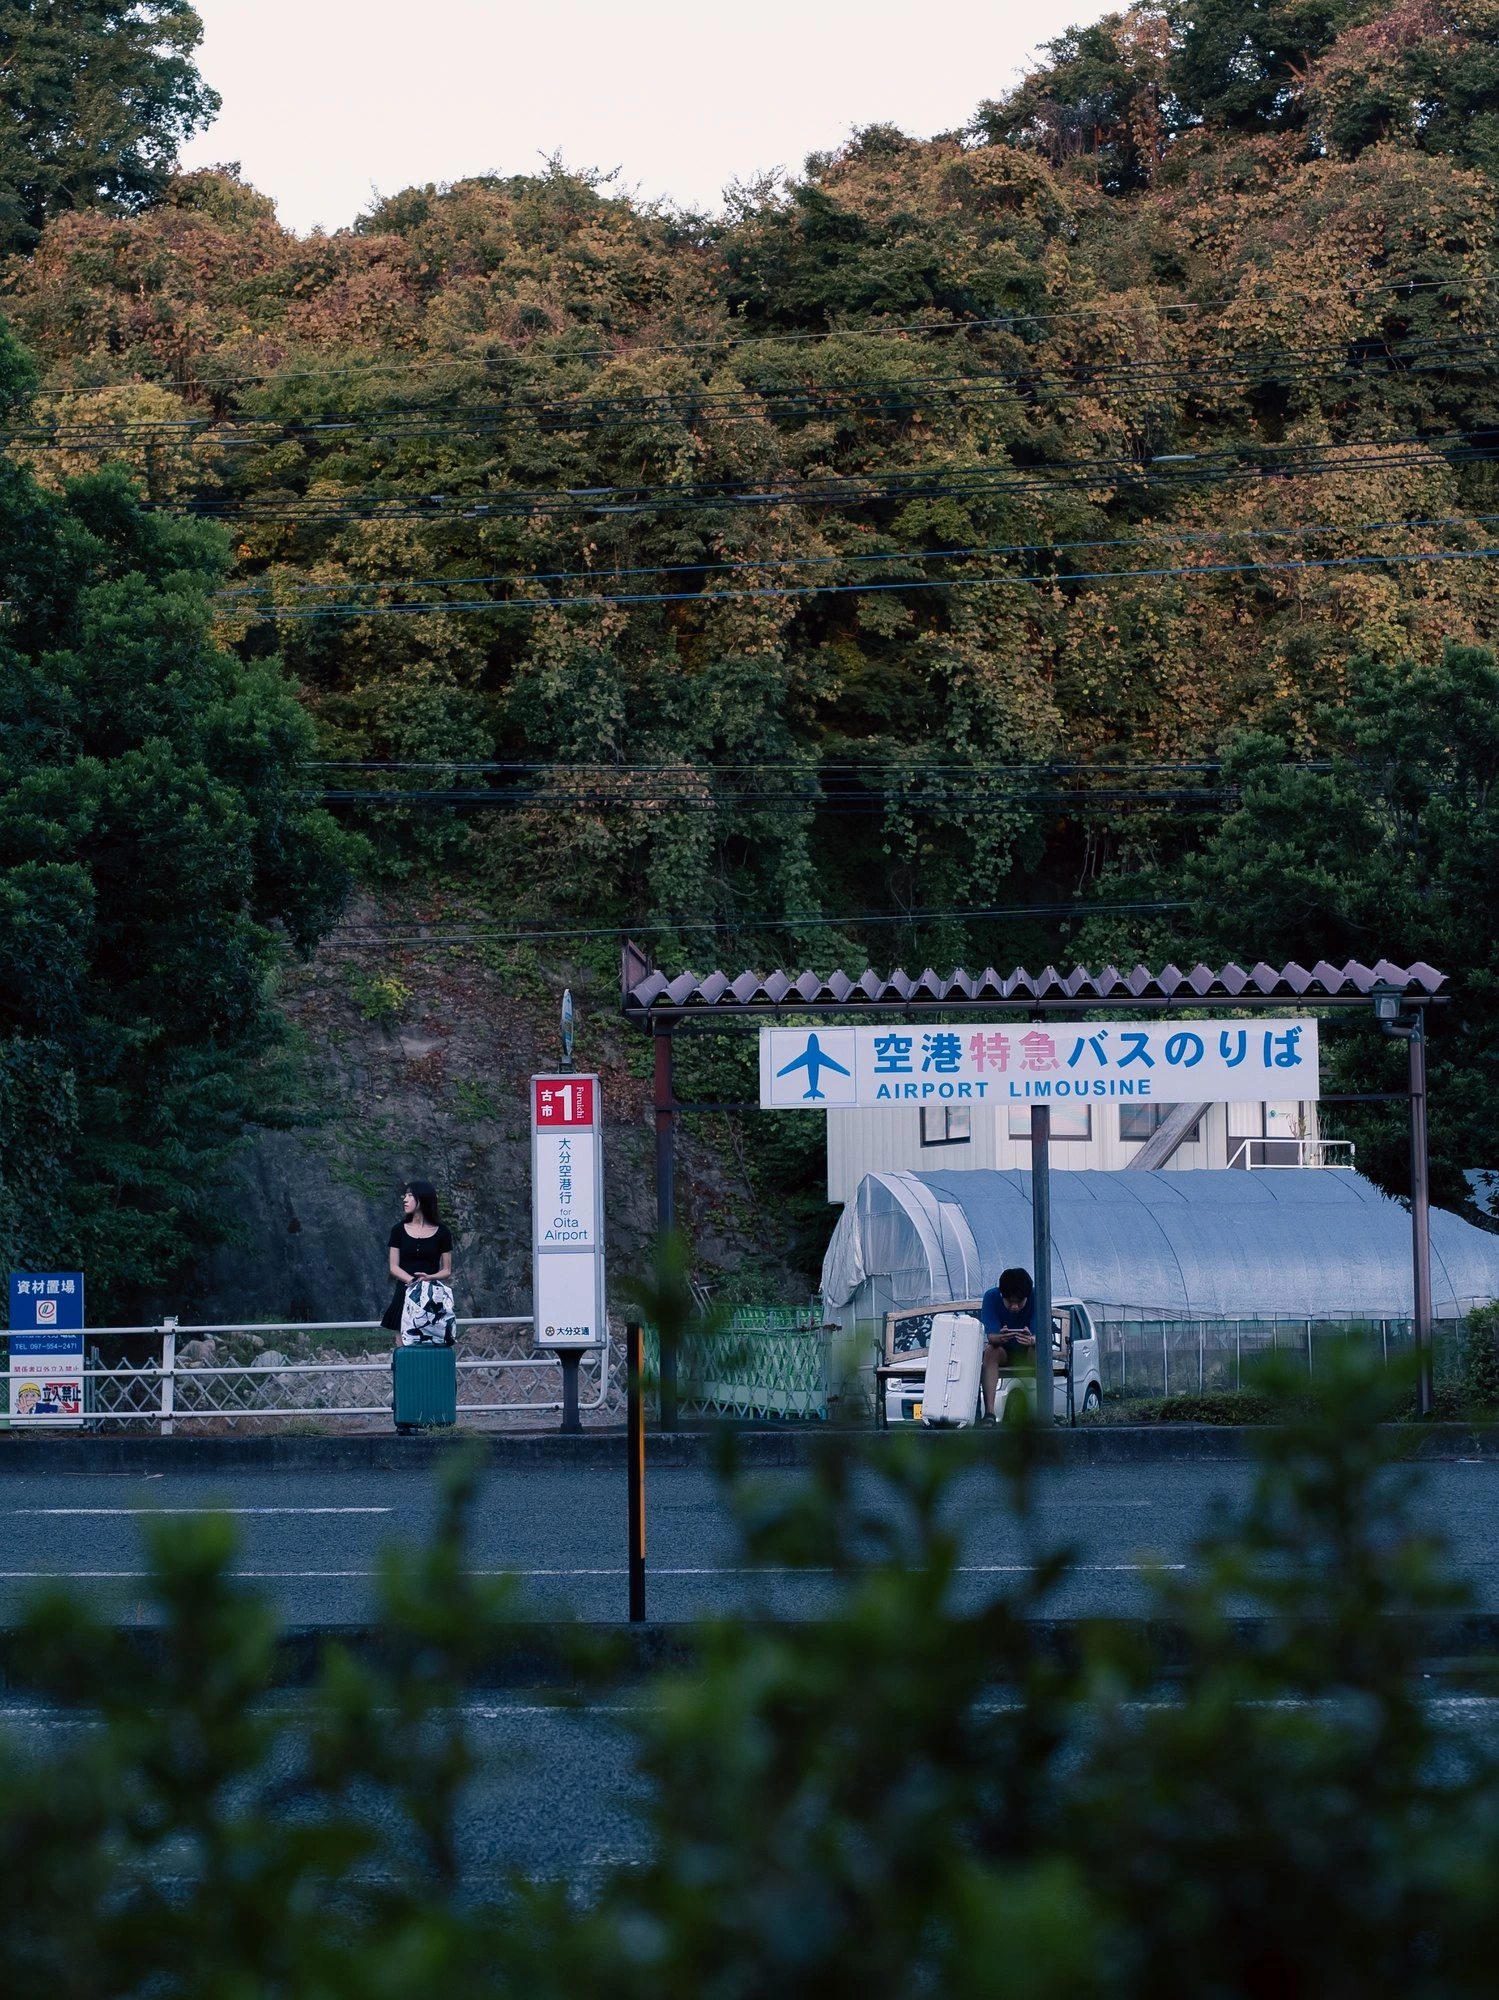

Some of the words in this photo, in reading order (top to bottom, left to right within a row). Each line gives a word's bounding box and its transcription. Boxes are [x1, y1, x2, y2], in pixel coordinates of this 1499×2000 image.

[873, 1026, 1303, 1073] 空港特急バスのりば
[876, 1081, 989, 1100] AIRPORT
[1009, 1079, 1152, 1098] LIMOUSINE
[540, 1089, 553, 1117] 古市
[554, 1084, 572, 1121] 1
[576, 1086, 584, 1119] Furuichi
[558, 1137, 572, 1205] 大分空港行
[560, 1208, 572, 1216] for
[553, 1217, 579, 1228] Oita
[544, 1229, 588, 1242] Airport
[17, 1279, 75, 1295] 資材置場
[556, 1326, 590, 1336] 大分交通
[42, 1385, 82, 1402] 立入禁止
